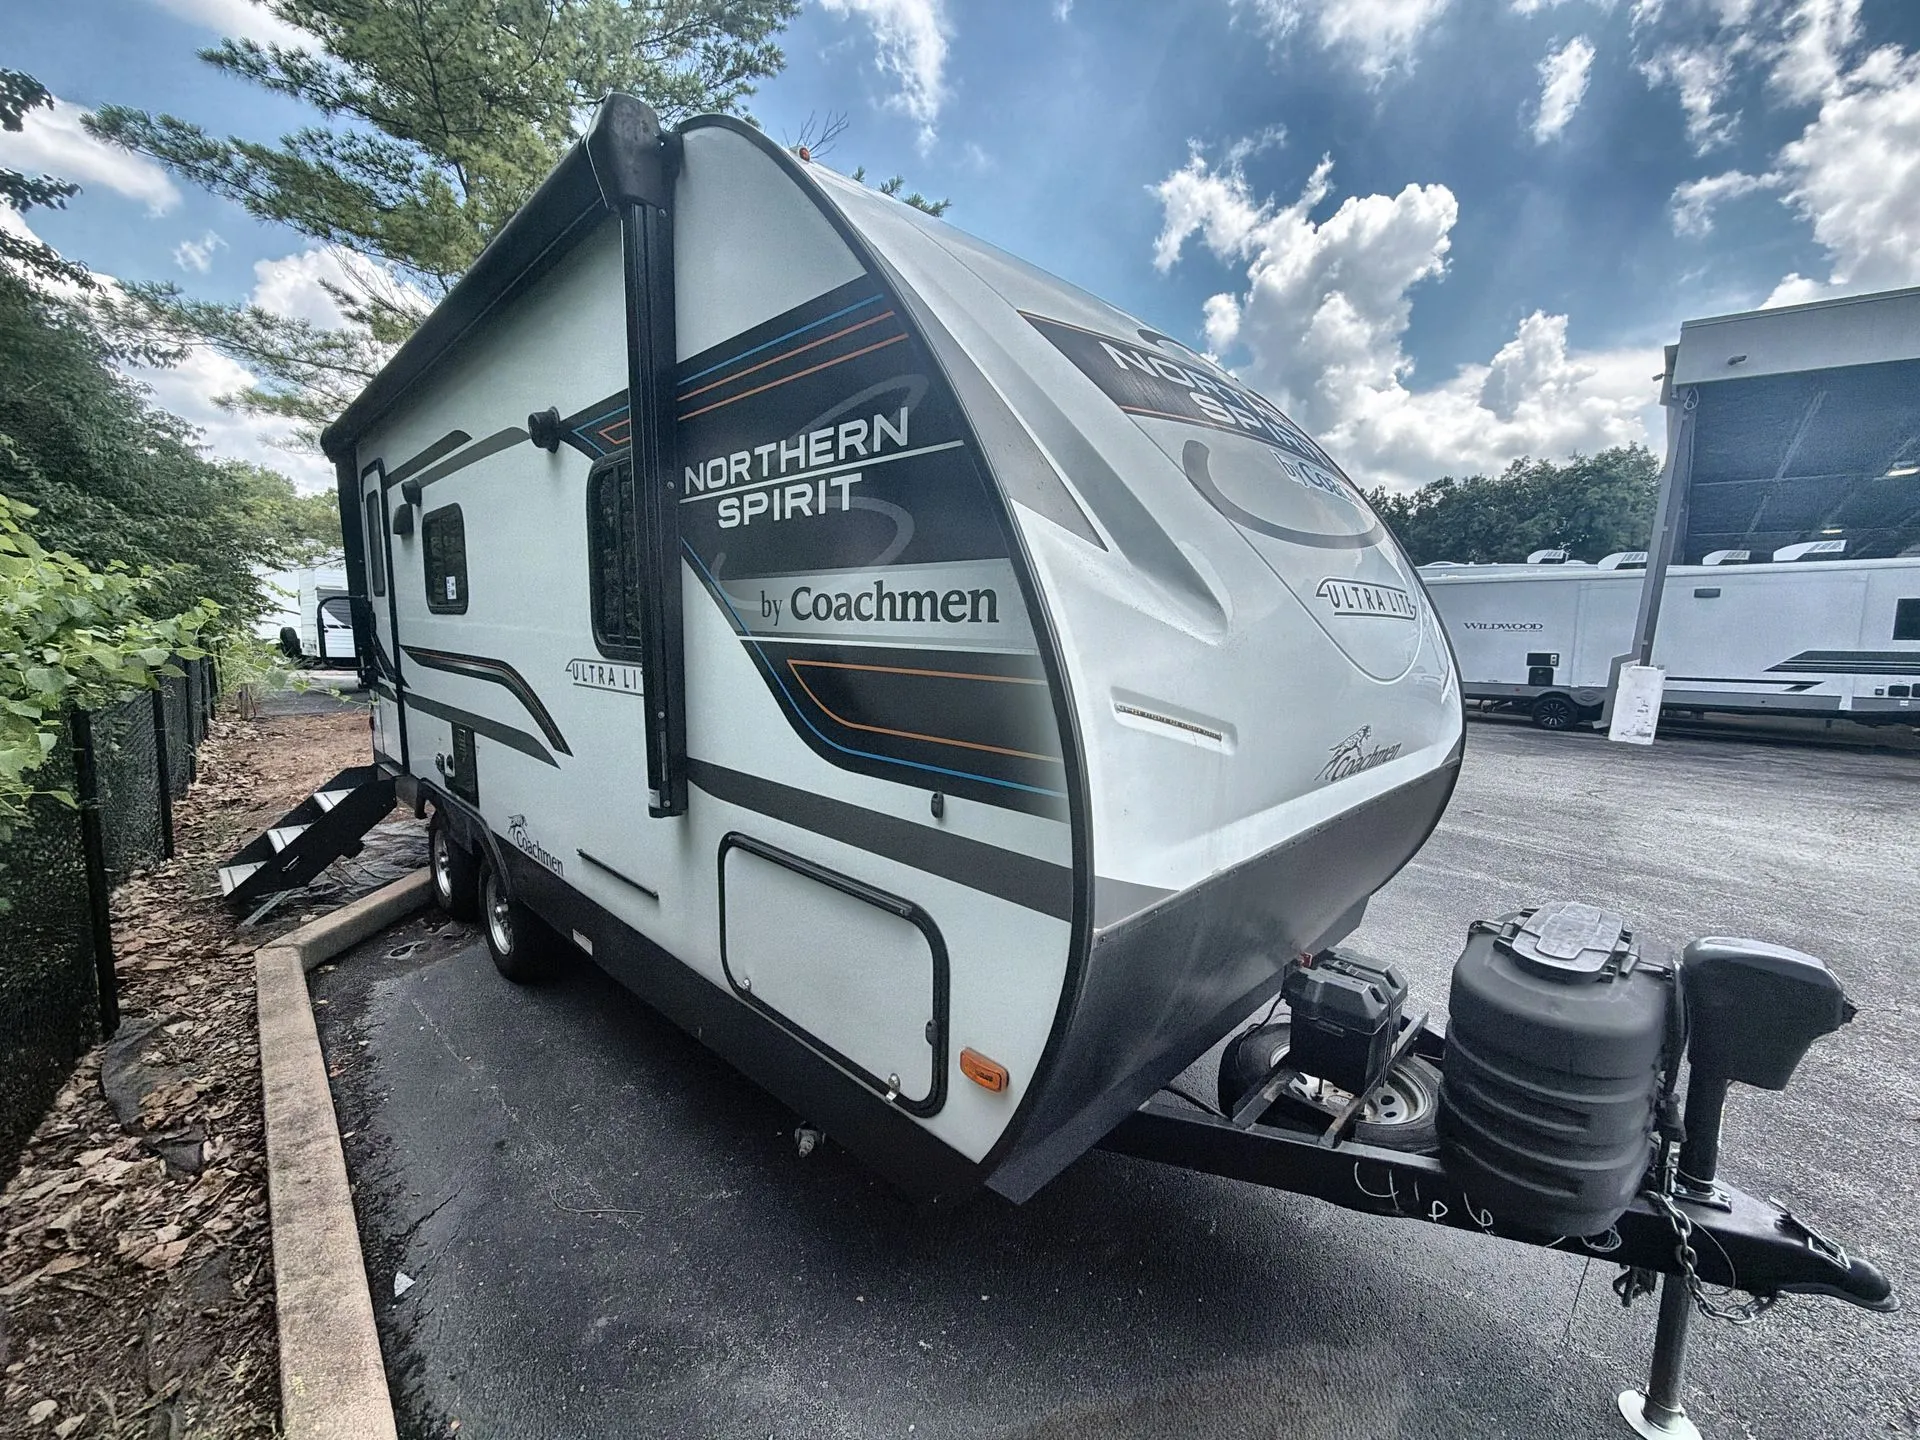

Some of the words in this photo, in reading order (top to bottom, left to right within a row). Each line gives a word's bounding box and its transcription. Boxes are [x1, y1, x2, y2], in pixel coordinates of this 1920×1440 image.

[684, 406, 909, 495] NORTHERN
[1273, 453, 1308, 487] by
[717, 472, 863, 529] SPIRIT
[761, 590, 783, 626] by
[790, 579, 999, 624] Coachmen
[1326, 584, 1386, 611] ULTRA
[1387, 591, 1414, 616] LITE
[1463, 622, 1544, 630] WILDWOOD
[572, 662, 616, 687] ULTRA
[623, 669, 645, 690] LI
[1330, 742, 1402, 782] Coachmen
[515, 829, 564, 878] Coachmen
